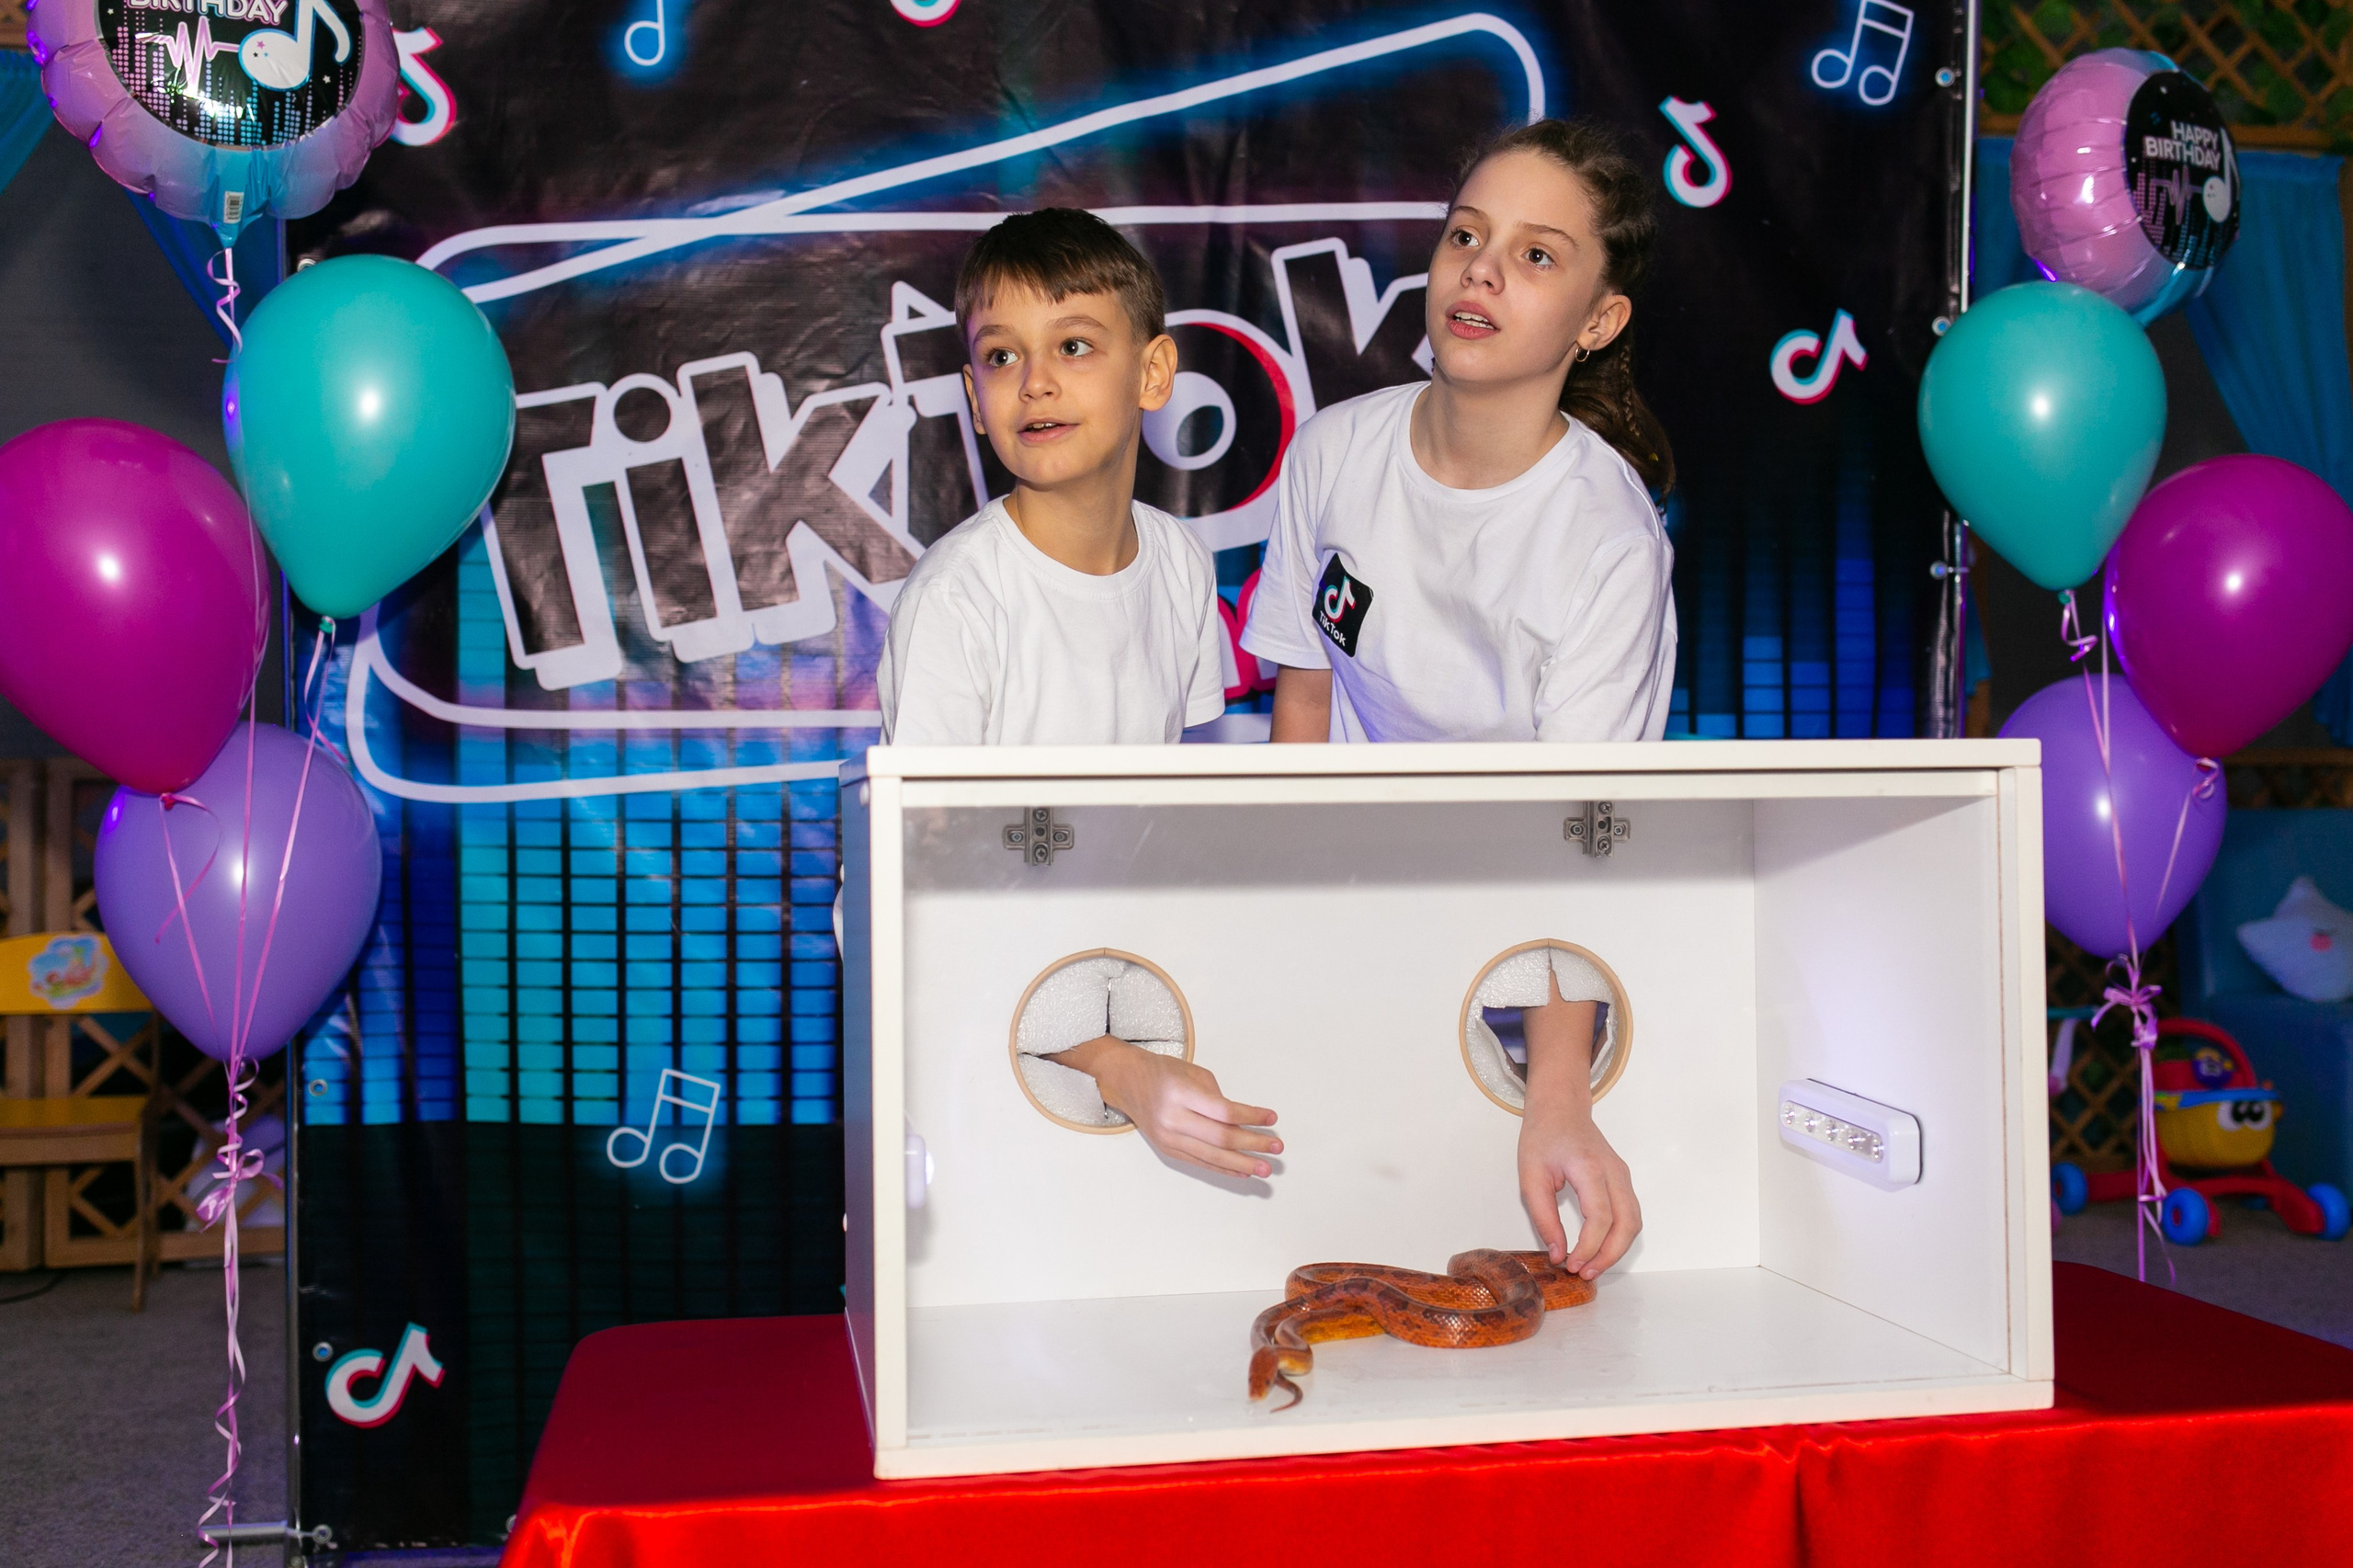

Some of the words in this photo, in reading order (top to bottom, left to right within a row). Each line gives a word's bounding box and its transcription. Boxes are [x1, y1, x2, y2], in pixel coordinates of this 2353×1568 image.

[127, 0, 288, 26] HDAY
[2170, 119, 2219, 151] HAPPY
[2143, 135, 2222, 171] BIRTHDAY
[1319, 610, 1347, 647] TikTok
